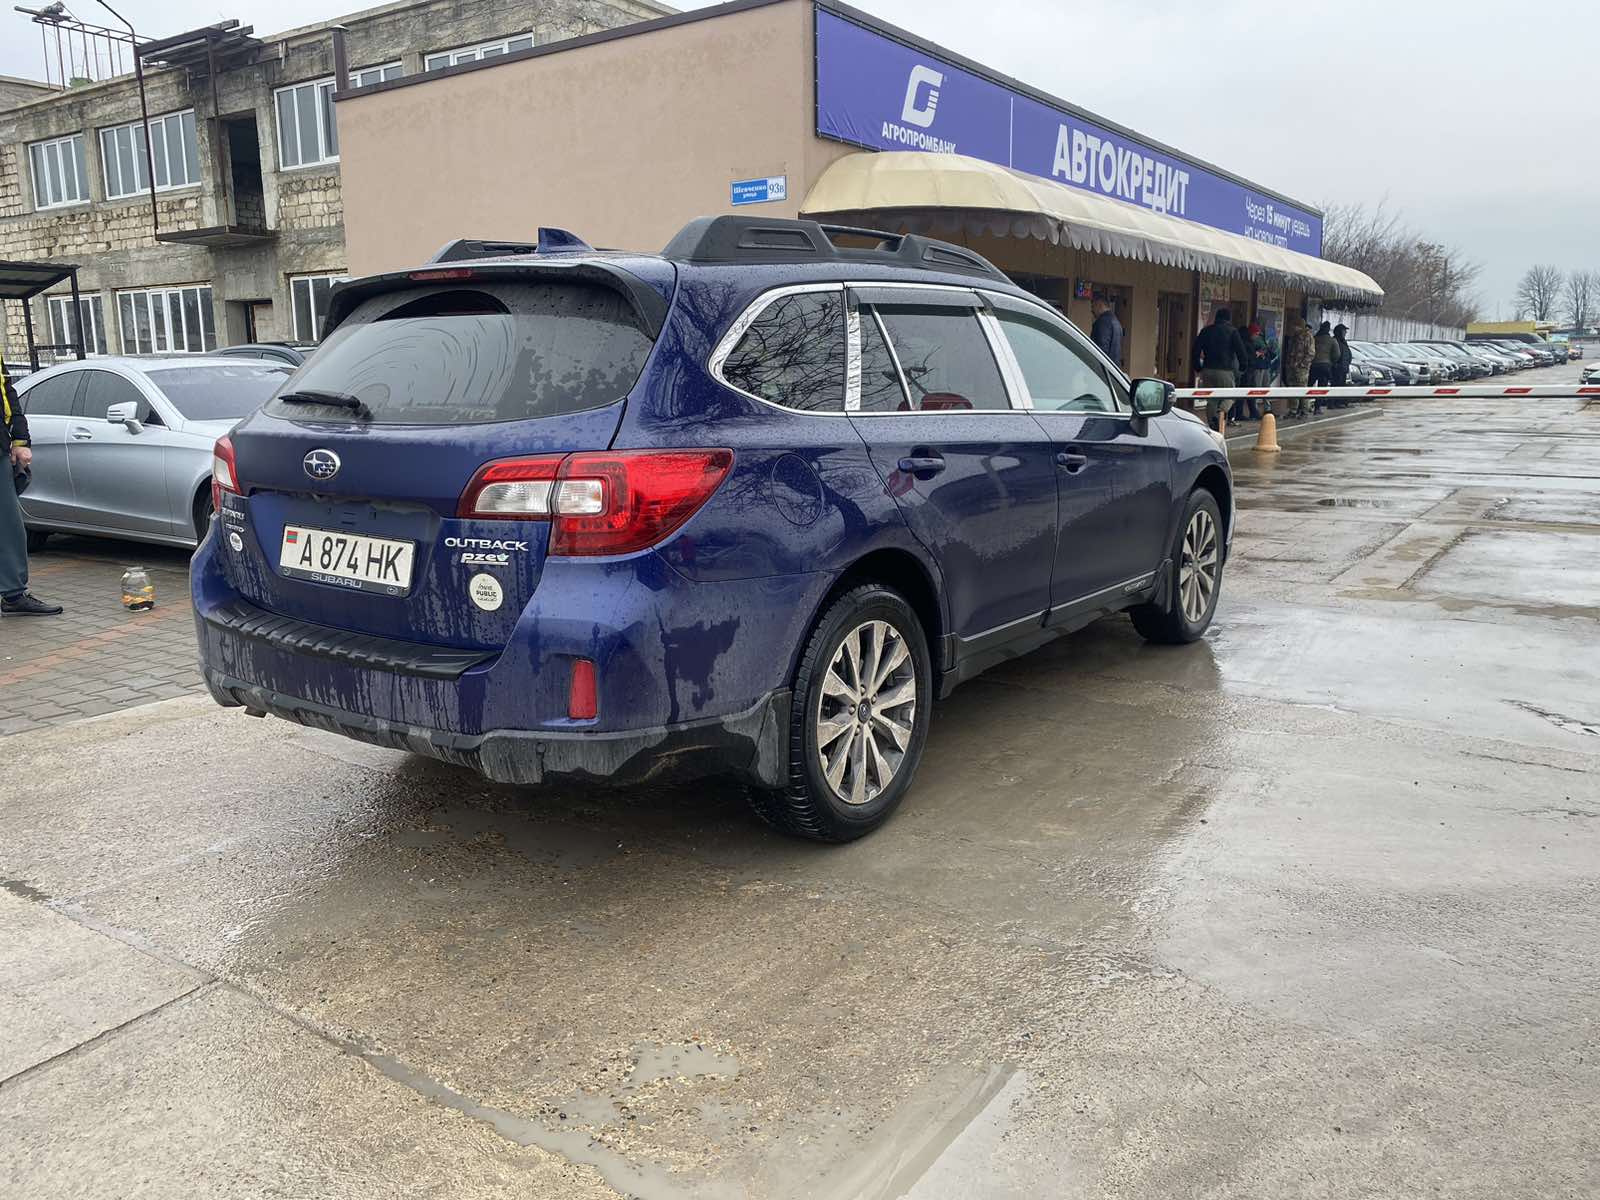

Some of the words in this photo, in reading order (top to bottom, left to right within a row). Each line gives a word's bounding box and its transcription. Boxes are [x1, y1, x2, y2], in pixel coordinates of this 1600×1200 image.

[881, 121, 957, 154] АГРОПРОМБАНК
[1052, 123, 1190, 214] АВТОКРЕДИТ
[1245, 195, 1265, 224] Через
[1266, 204, 1273, 224] 15
[300, 533, 313, 567] A
[320, 536, 358, 574] 874
[365, 542, 404, 581] HK
[444, 537, 529, 551] OUTBACK
[311, 572, 362, 588] SUBARU
[475, 590, 497, 598] PUBLIC
